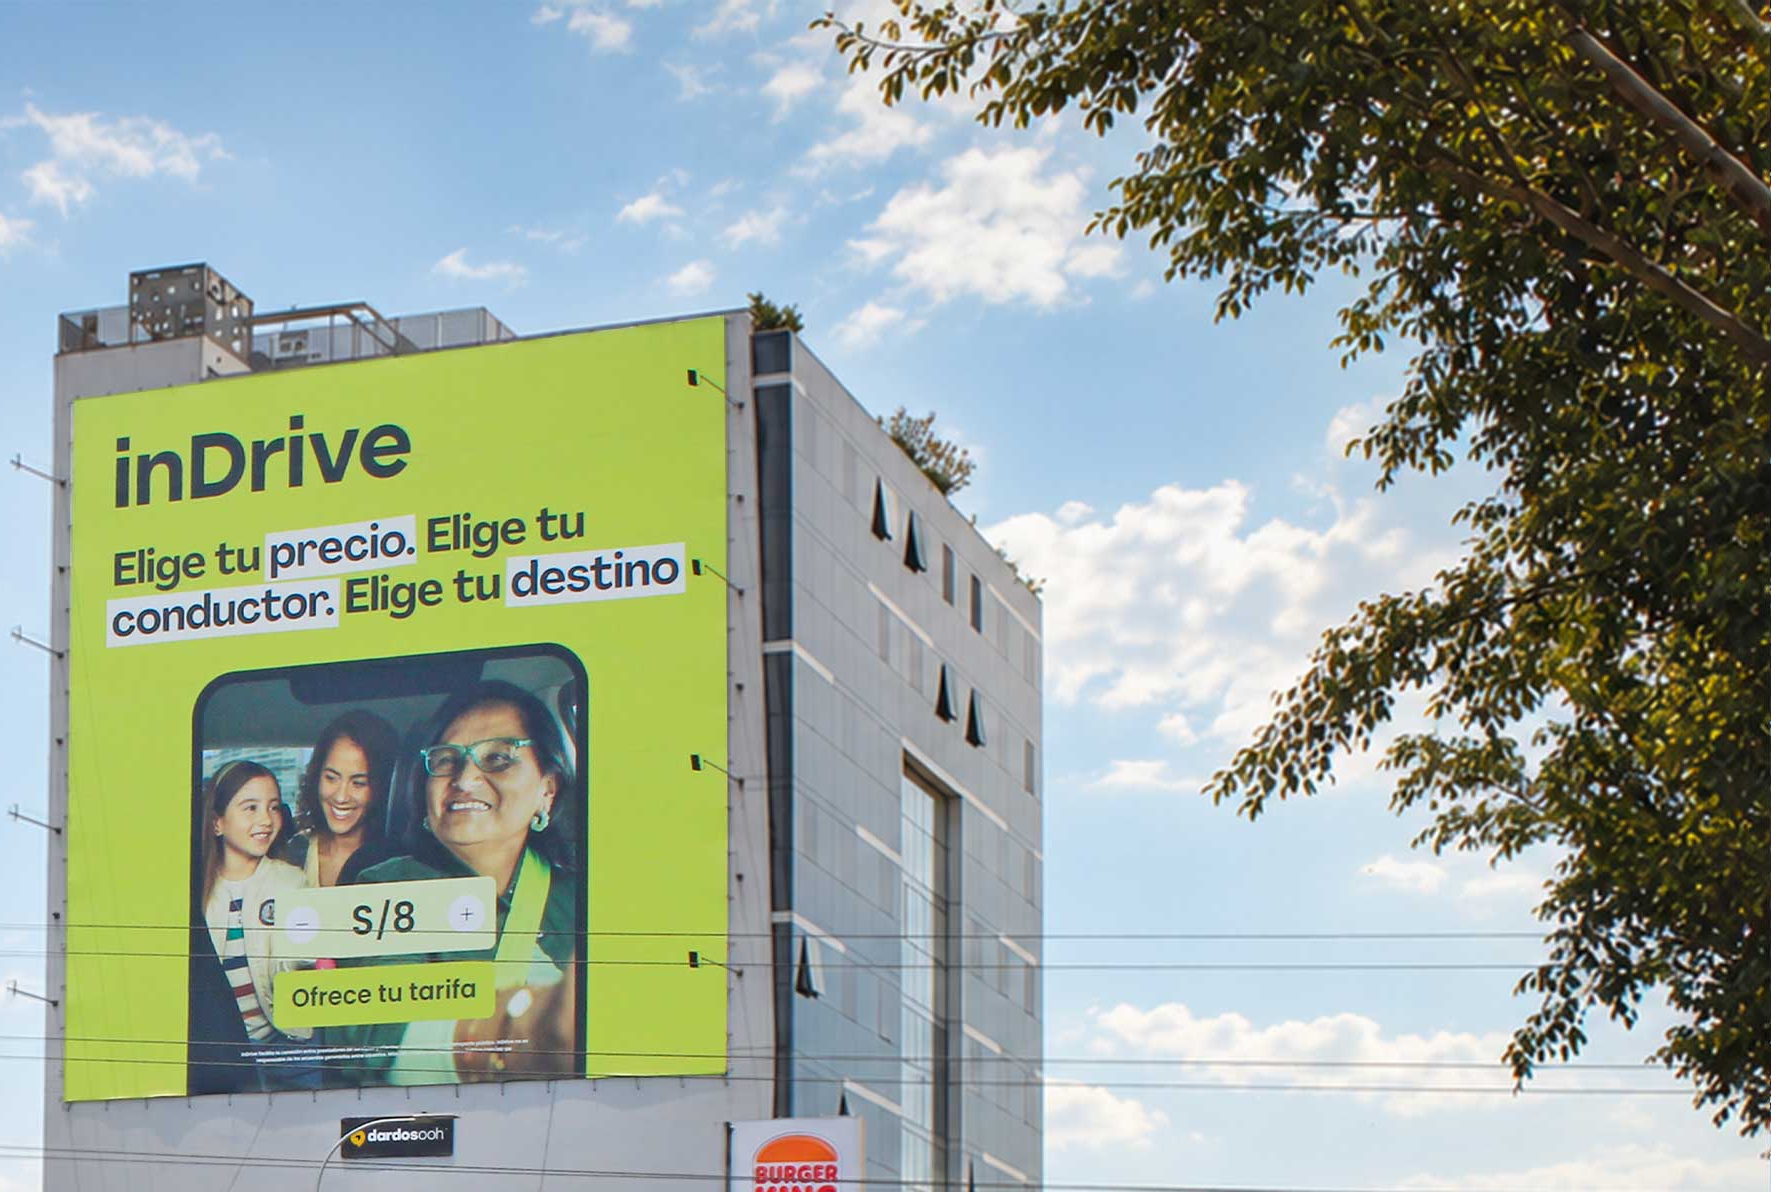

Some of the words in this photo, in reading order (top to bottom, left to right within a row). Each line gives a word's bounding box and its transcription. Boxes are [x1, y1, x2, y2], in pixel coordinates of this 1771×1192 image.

[114, 414, 412, 509] inDrive
[113, 549, 206, 590] Elige
[215, 540, 260, 574] tu
[270, 521, 416, 572] precio.
[427, 512, 526, 559] Elige
[537, 505, 585, 541] tu
[112, 590, 335, 640] conductor.
[345, 575, 443, 620] Elige
[453, 568, 501, 602] tu
[511, 549, 680, 599] destino
[351, 898, 416, 940] S/8
[291, 983, 372, 1011] Ofrece
[378, 981, 403, 1004] tu
[409, 978, 477, 1003] tarifa
[367, 1127, 445, 1143] dardosooh
[754, 1163, 838, 1185] BURGER
